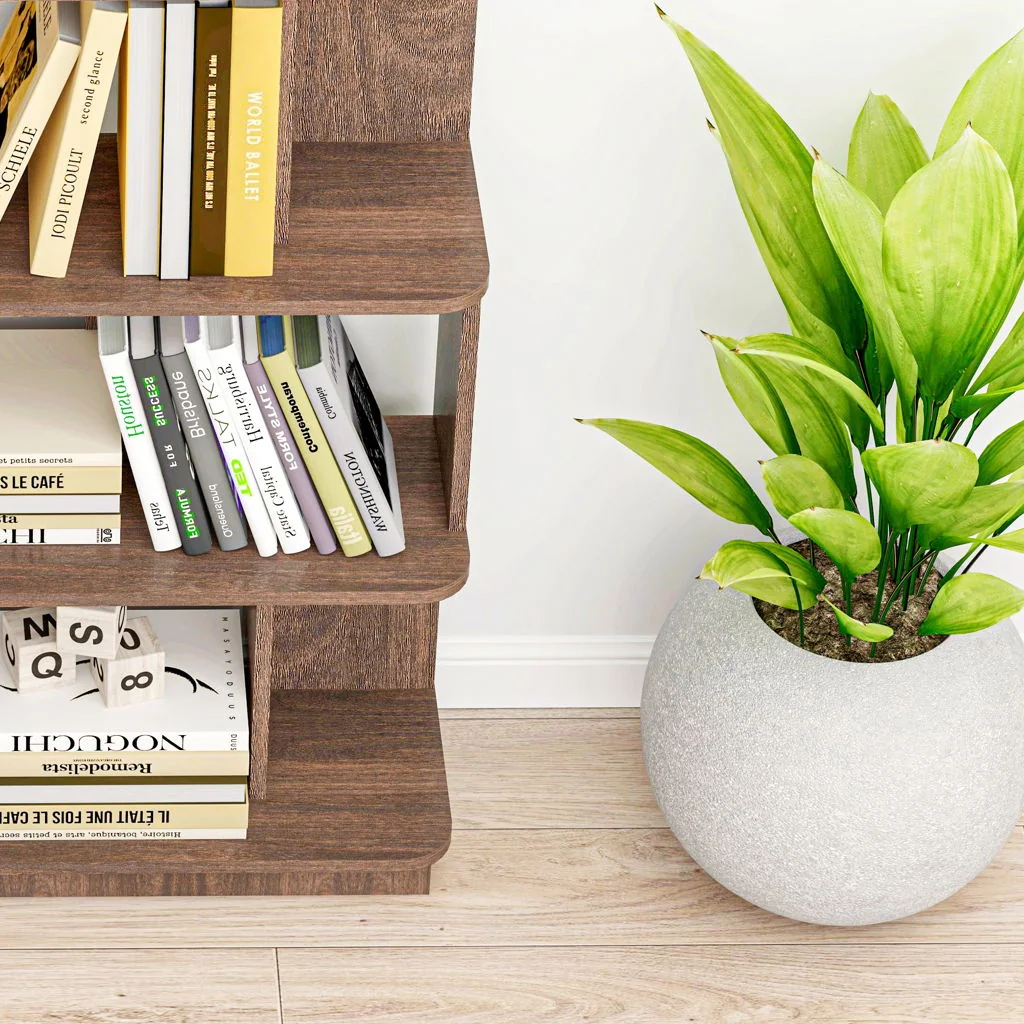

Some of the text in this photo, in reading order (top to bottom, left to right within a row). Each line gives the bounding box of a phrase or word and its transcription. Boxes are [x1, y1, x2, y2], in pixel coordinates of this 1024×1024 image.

[80, 50, 104, 125] second glance
[244, 92, 264, 202] WORLD BALLET
[51, 148, 84, 239] JODI PICOULT
[10, 458, 36, 466] petits
[12, 476, 28, 488] LE
[31, 473, 64, 488] CAFÉ
[70, 622, 104, 646] S
[32, 652, 63, 678] Q
[121, 671, 154, 691] 8
[12, 734, 186, 752] NOGUCHI
[42, 762, 152, 775] Remodelista
[32, 812, 48, 824] LE
[52, 811, 82, 824] FOIS
[86, 811, 112, 824] UNE
[116, 811, 154, 826] ÉTAIT
[158, 811, 170, 824] IL
[88, 831, 136, 839] botanique,
